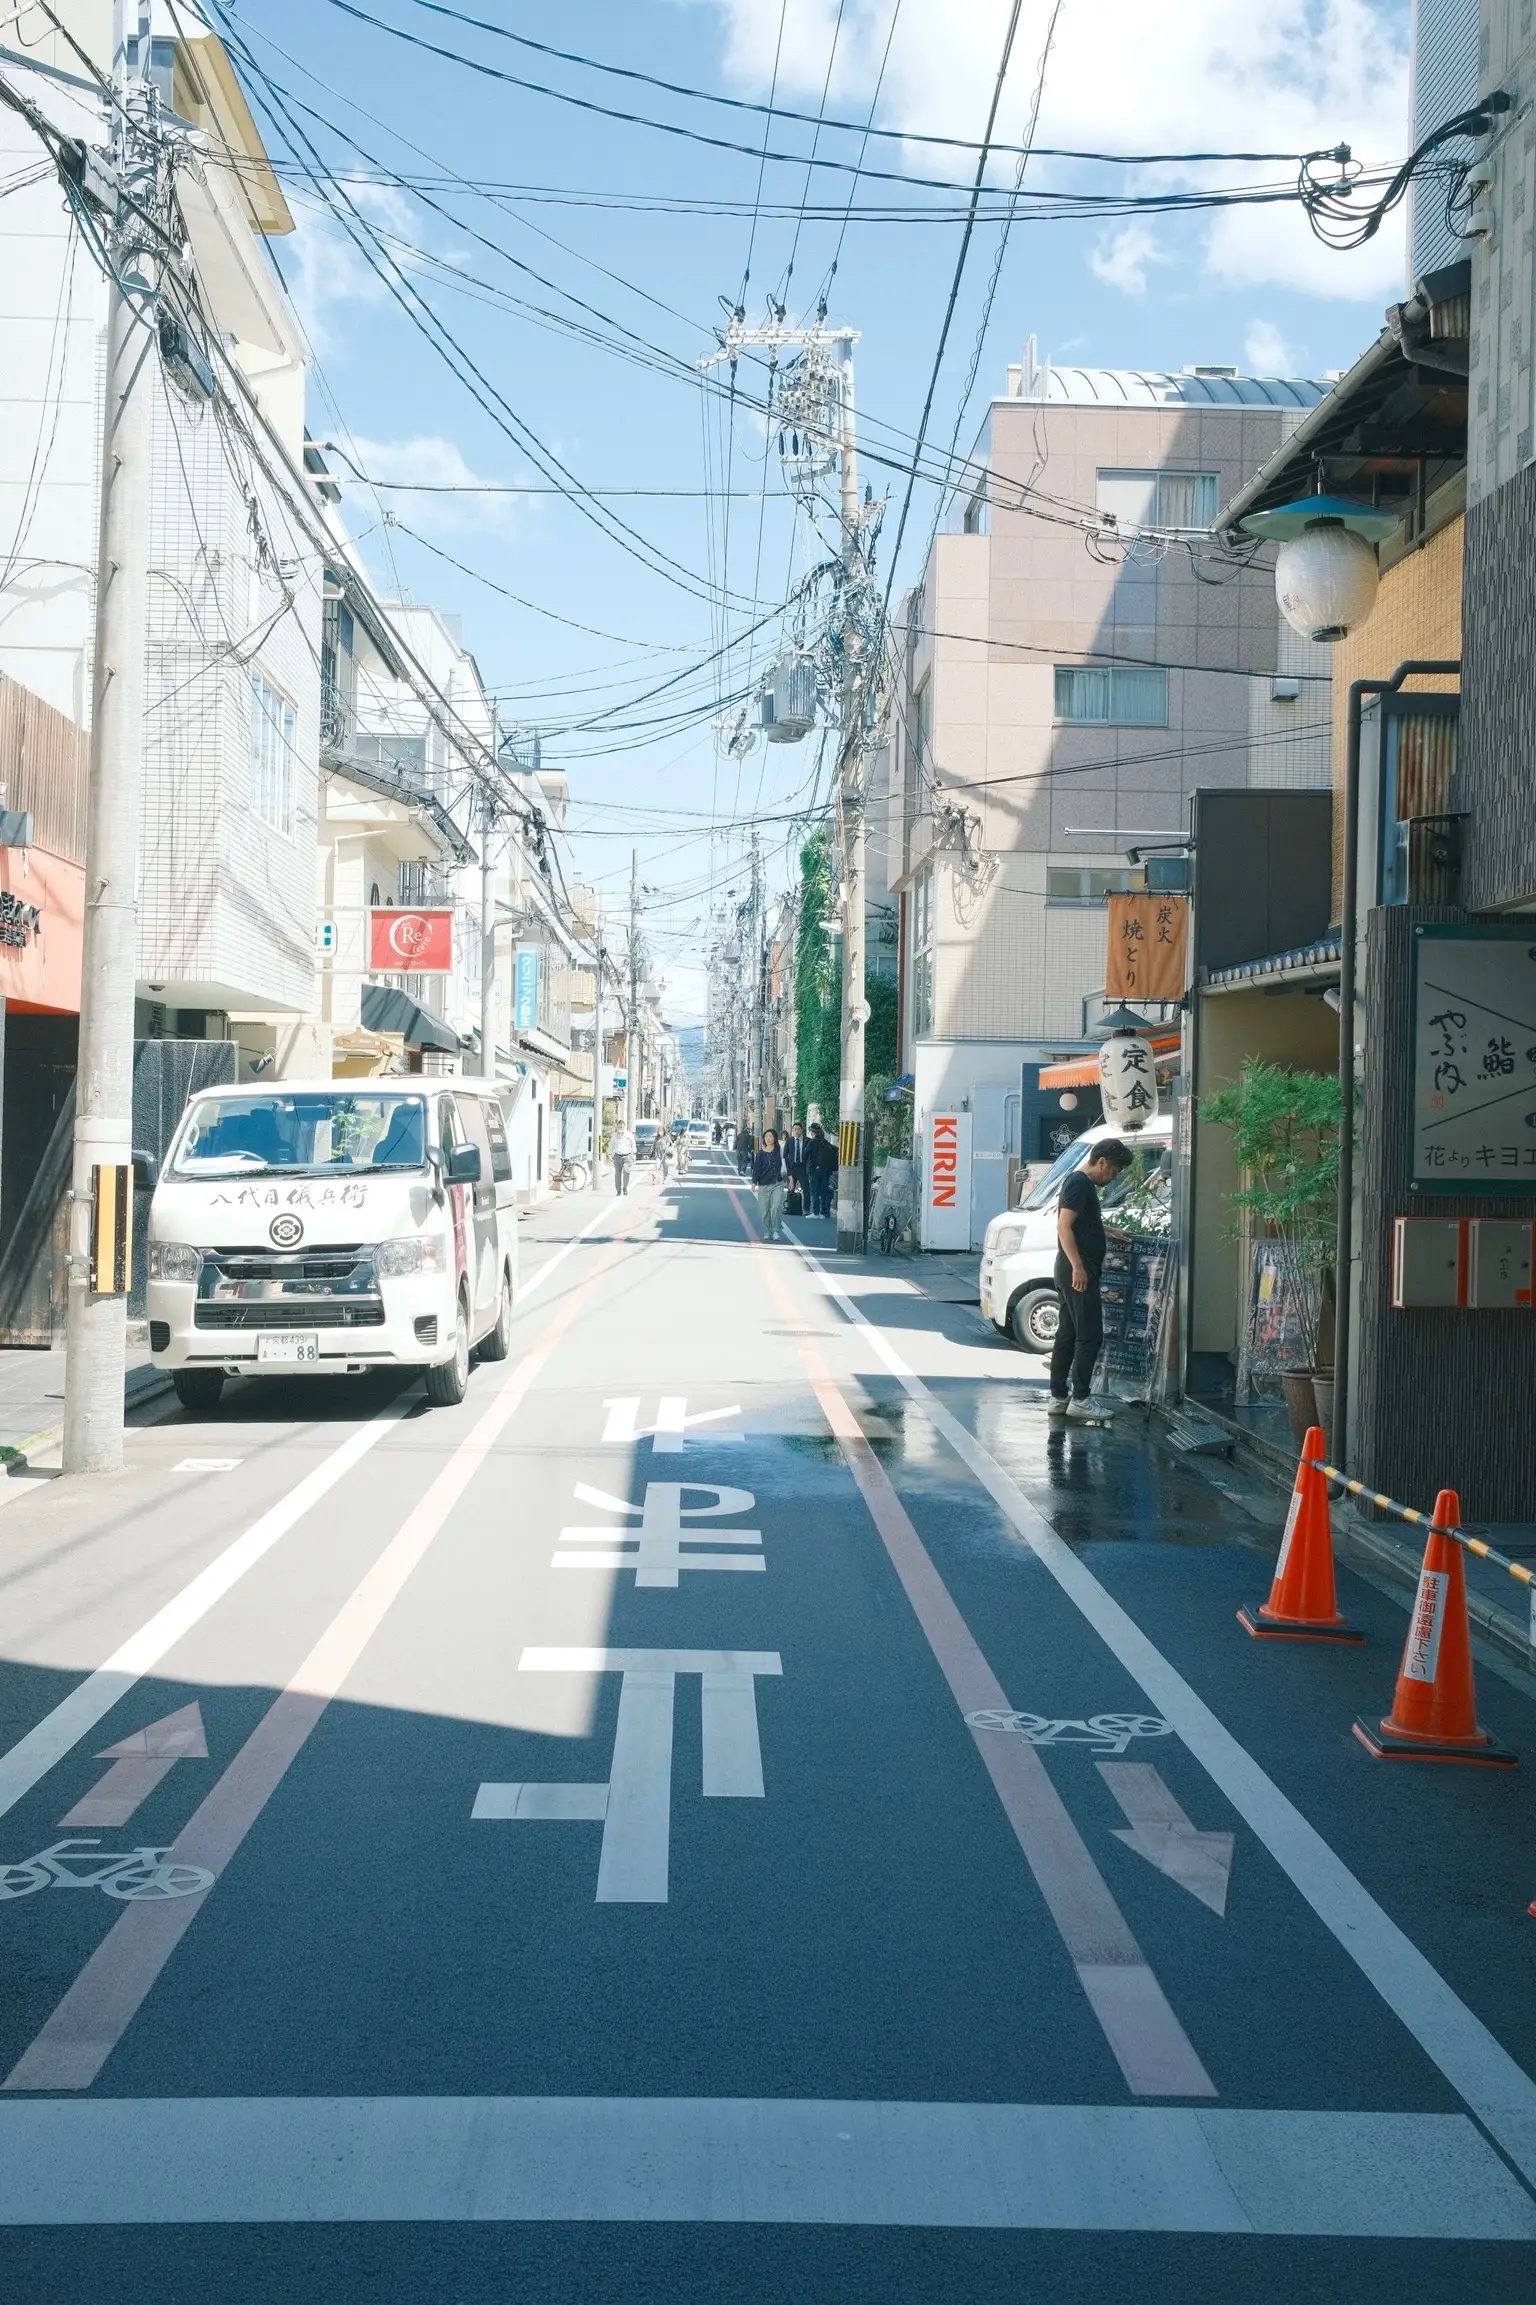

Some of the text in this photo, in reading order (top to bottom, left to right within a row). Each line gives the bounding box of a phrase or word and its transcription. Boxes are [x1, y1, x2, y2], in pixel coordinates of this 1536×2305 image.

[1122, 919, 1144, 988] 焼とり
[1156, 906, 1173, 944] 炭火
[1121, 1044, 1153, 1111] 定食
[1477, 1036, 1517, 1081] 鮨
[932, 1118, 958, 1207] KIRIN
[471, 1396, 783, 1903] 止まれ
